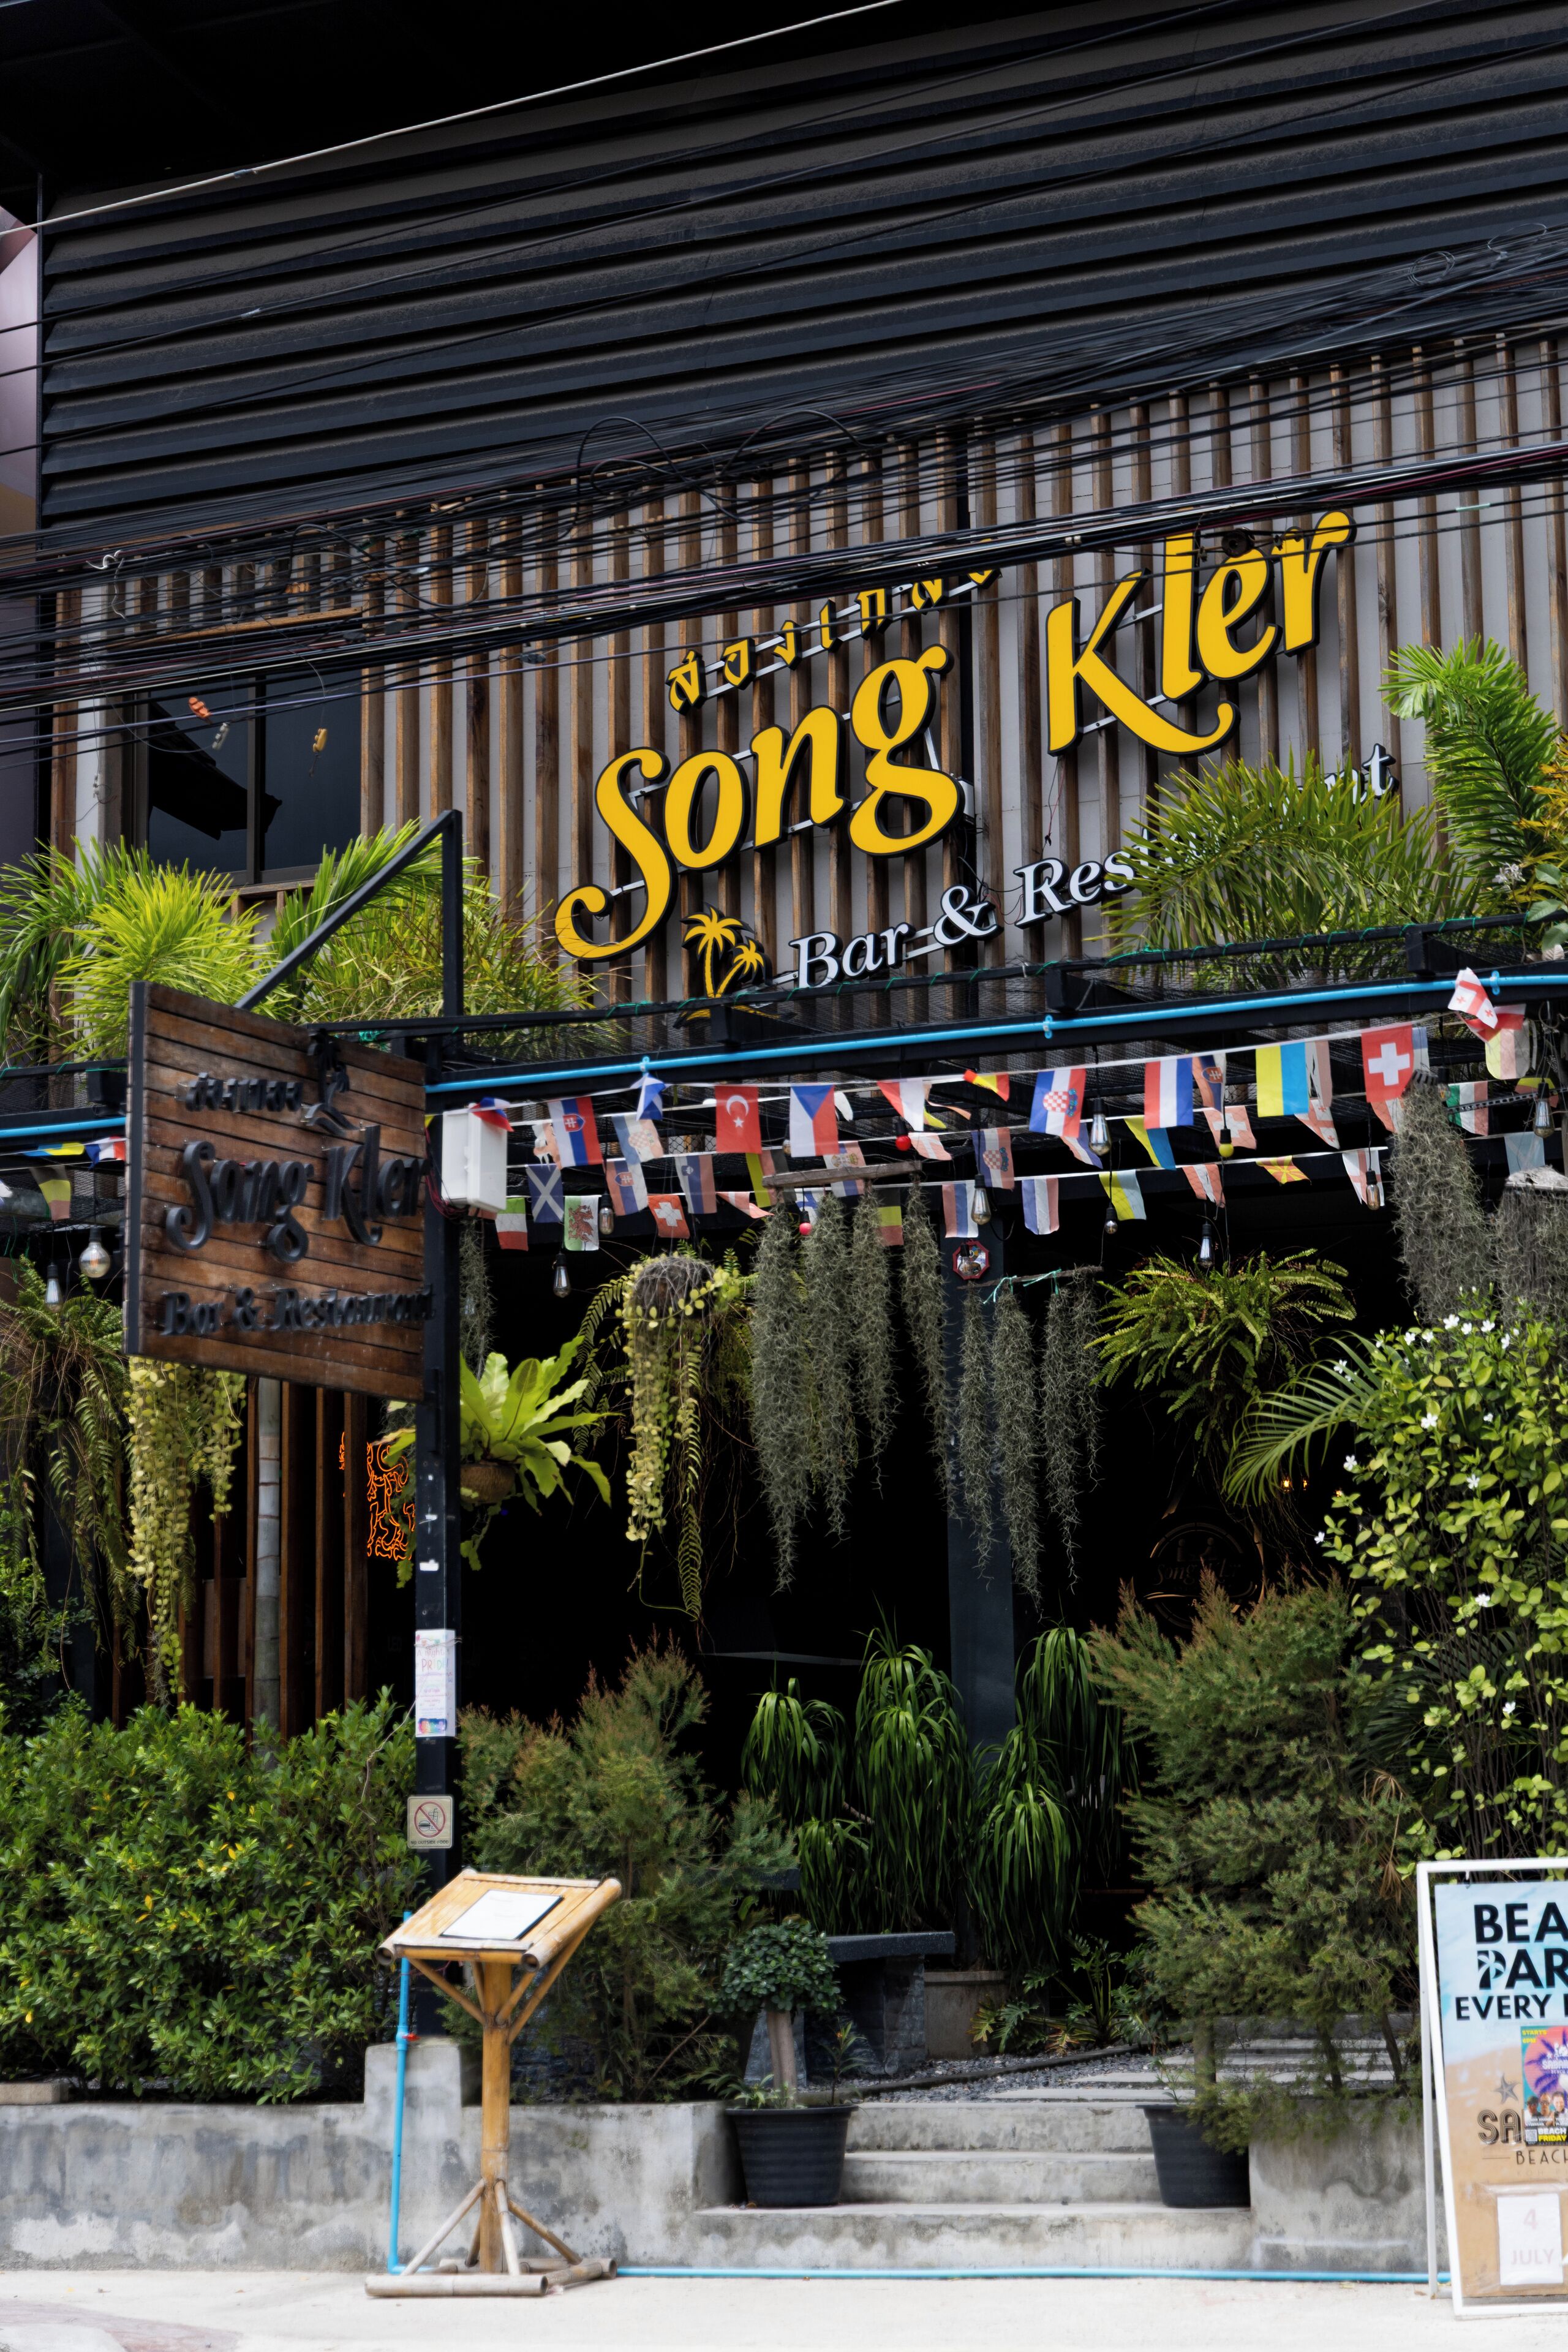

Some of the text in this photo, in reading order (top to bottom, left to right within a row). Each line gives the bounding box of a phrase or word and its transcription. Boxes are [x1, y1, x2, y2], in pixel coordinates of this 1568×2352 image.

[555, 507, 1349, 958] Song Kler
[790, 923, 910, 988] Bar
[934, 886, 997, 946] &
[166, 1125, 426, 1262] Song Kler
[160, 1284, 435, 1336] Bar & Restaurant
[1455, 1993, 1552, 2021] EVERY
[1477, 2109, 1525, 2145] SA
[1523, 2208, 1539, 2230] 4
[1510, 2248, 1555, 2265] JULY
